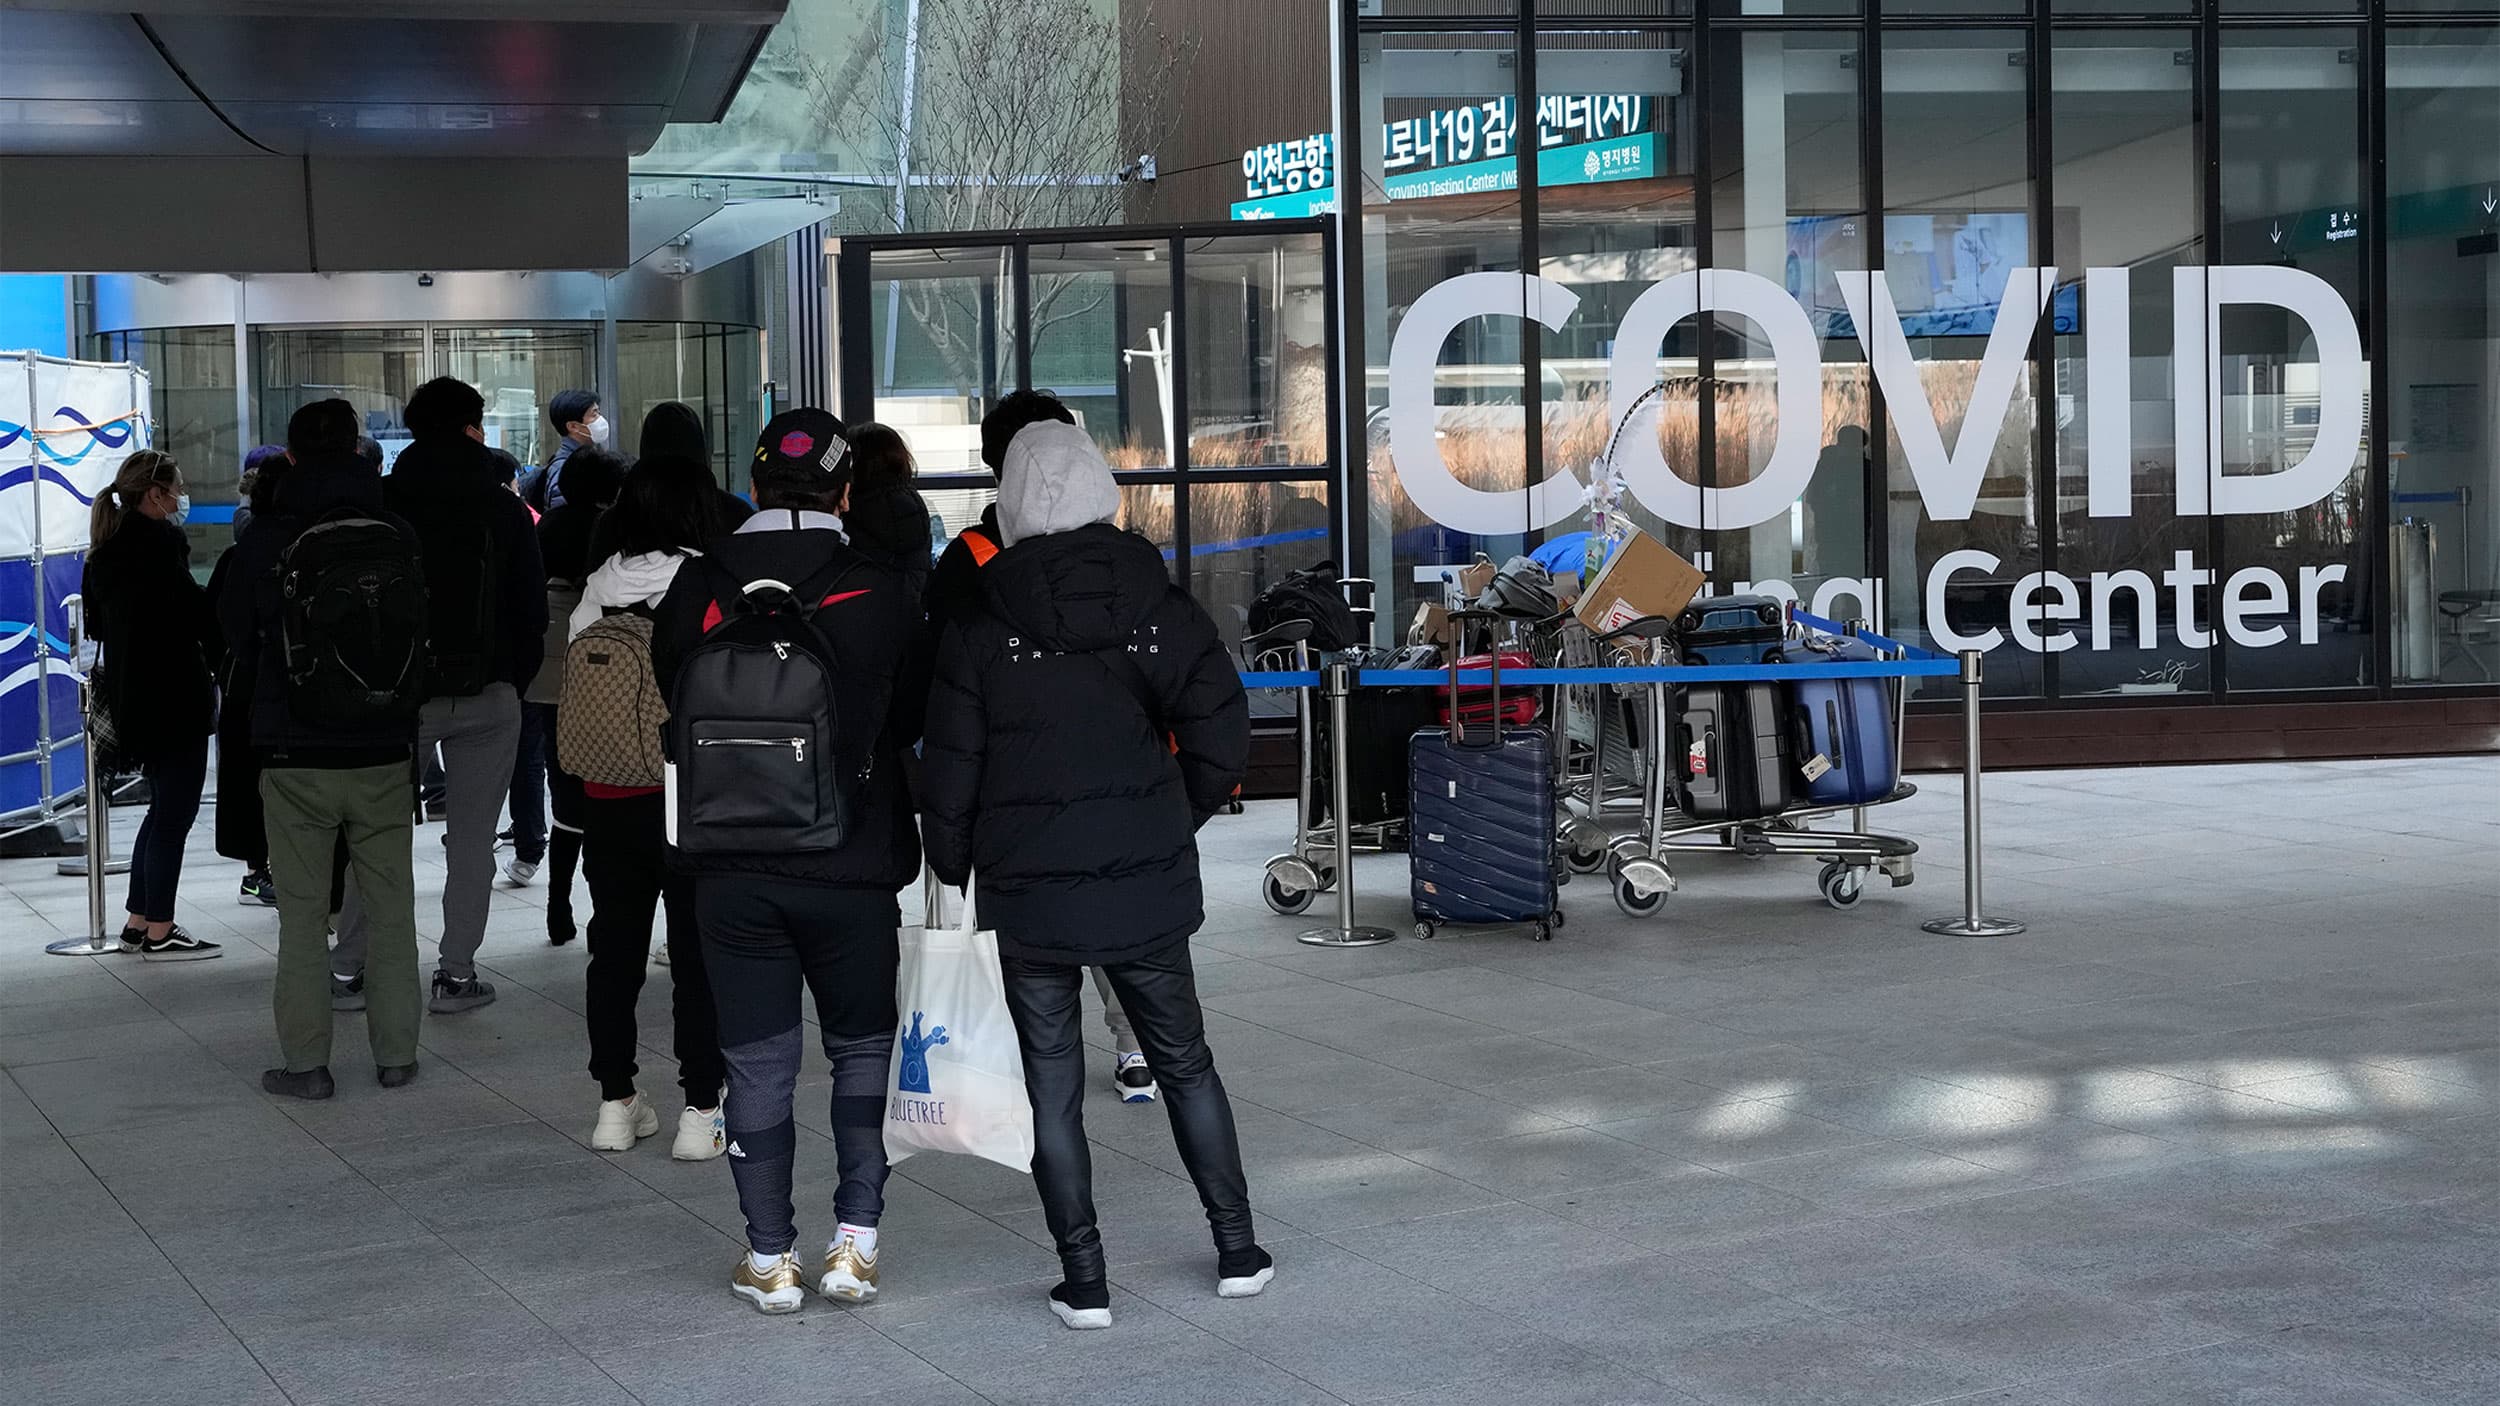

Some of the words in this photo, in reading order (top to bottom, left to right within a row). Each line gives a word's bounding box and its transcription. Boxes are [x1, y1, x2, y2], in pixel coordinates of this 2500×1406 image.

[1243, 133, 1326, 198] 인천공항
[1383, 106, 1475, 167] 로나19
[1602, 145, 1640, 168] 명지병원
[1430, 178, 1464, 197] Testing
[1465, 173, 1498, 191] Center
[2326, 228, 2357, 241] Registration
[1389, 266, 2361, 533] COVID
[1925, 549, 2347, 654] Center
